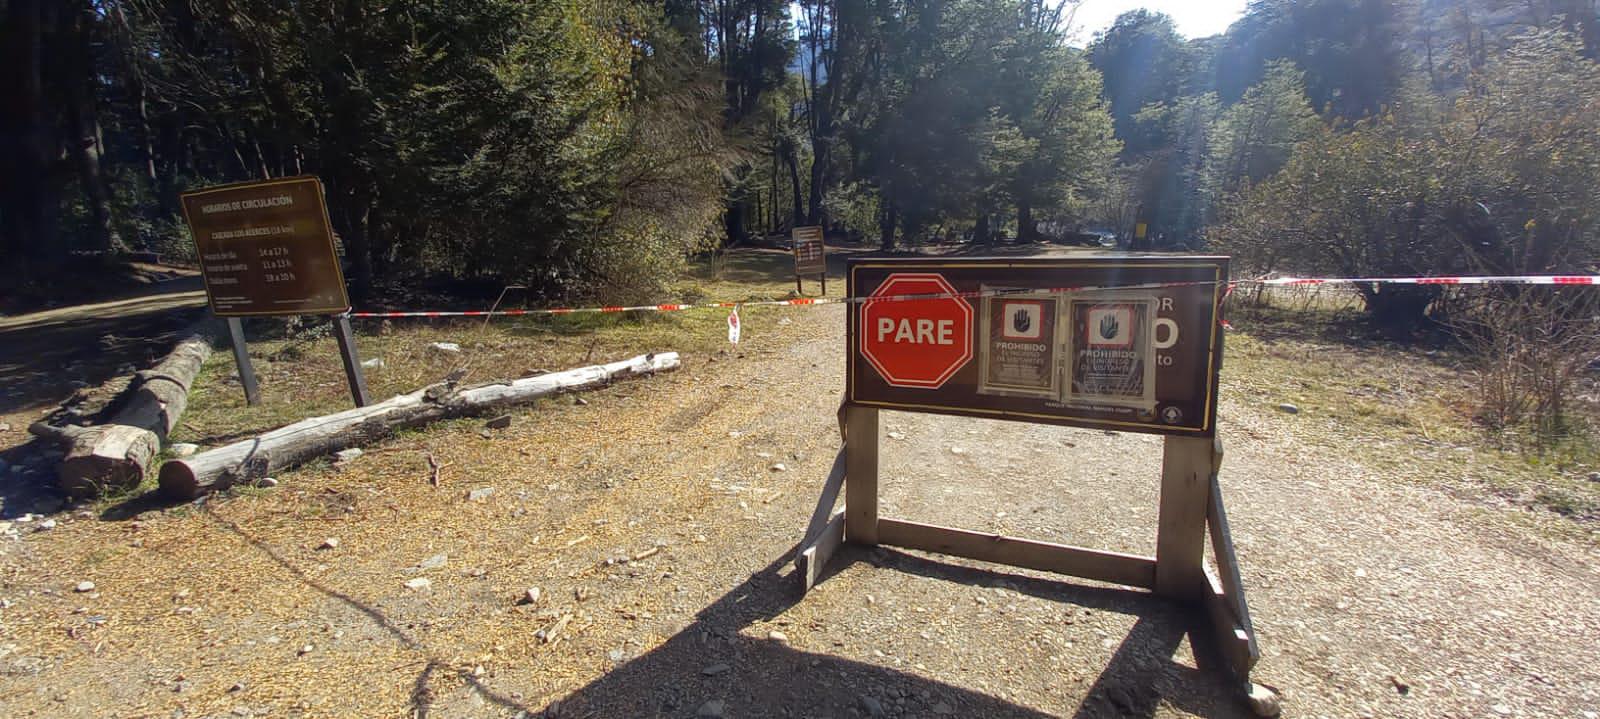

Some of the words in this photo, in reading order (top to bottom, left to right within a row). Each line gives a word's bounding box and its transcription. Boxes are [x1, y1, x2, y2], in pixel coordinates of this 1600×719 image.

[241, 195, 293, 210] CIRCULACIÓN
[877, 318, 954, 345] PARE
[996, 342, 1047, 352] PROHIBIDO
[1080, 350, 1137, 359] PROHIBIDO
